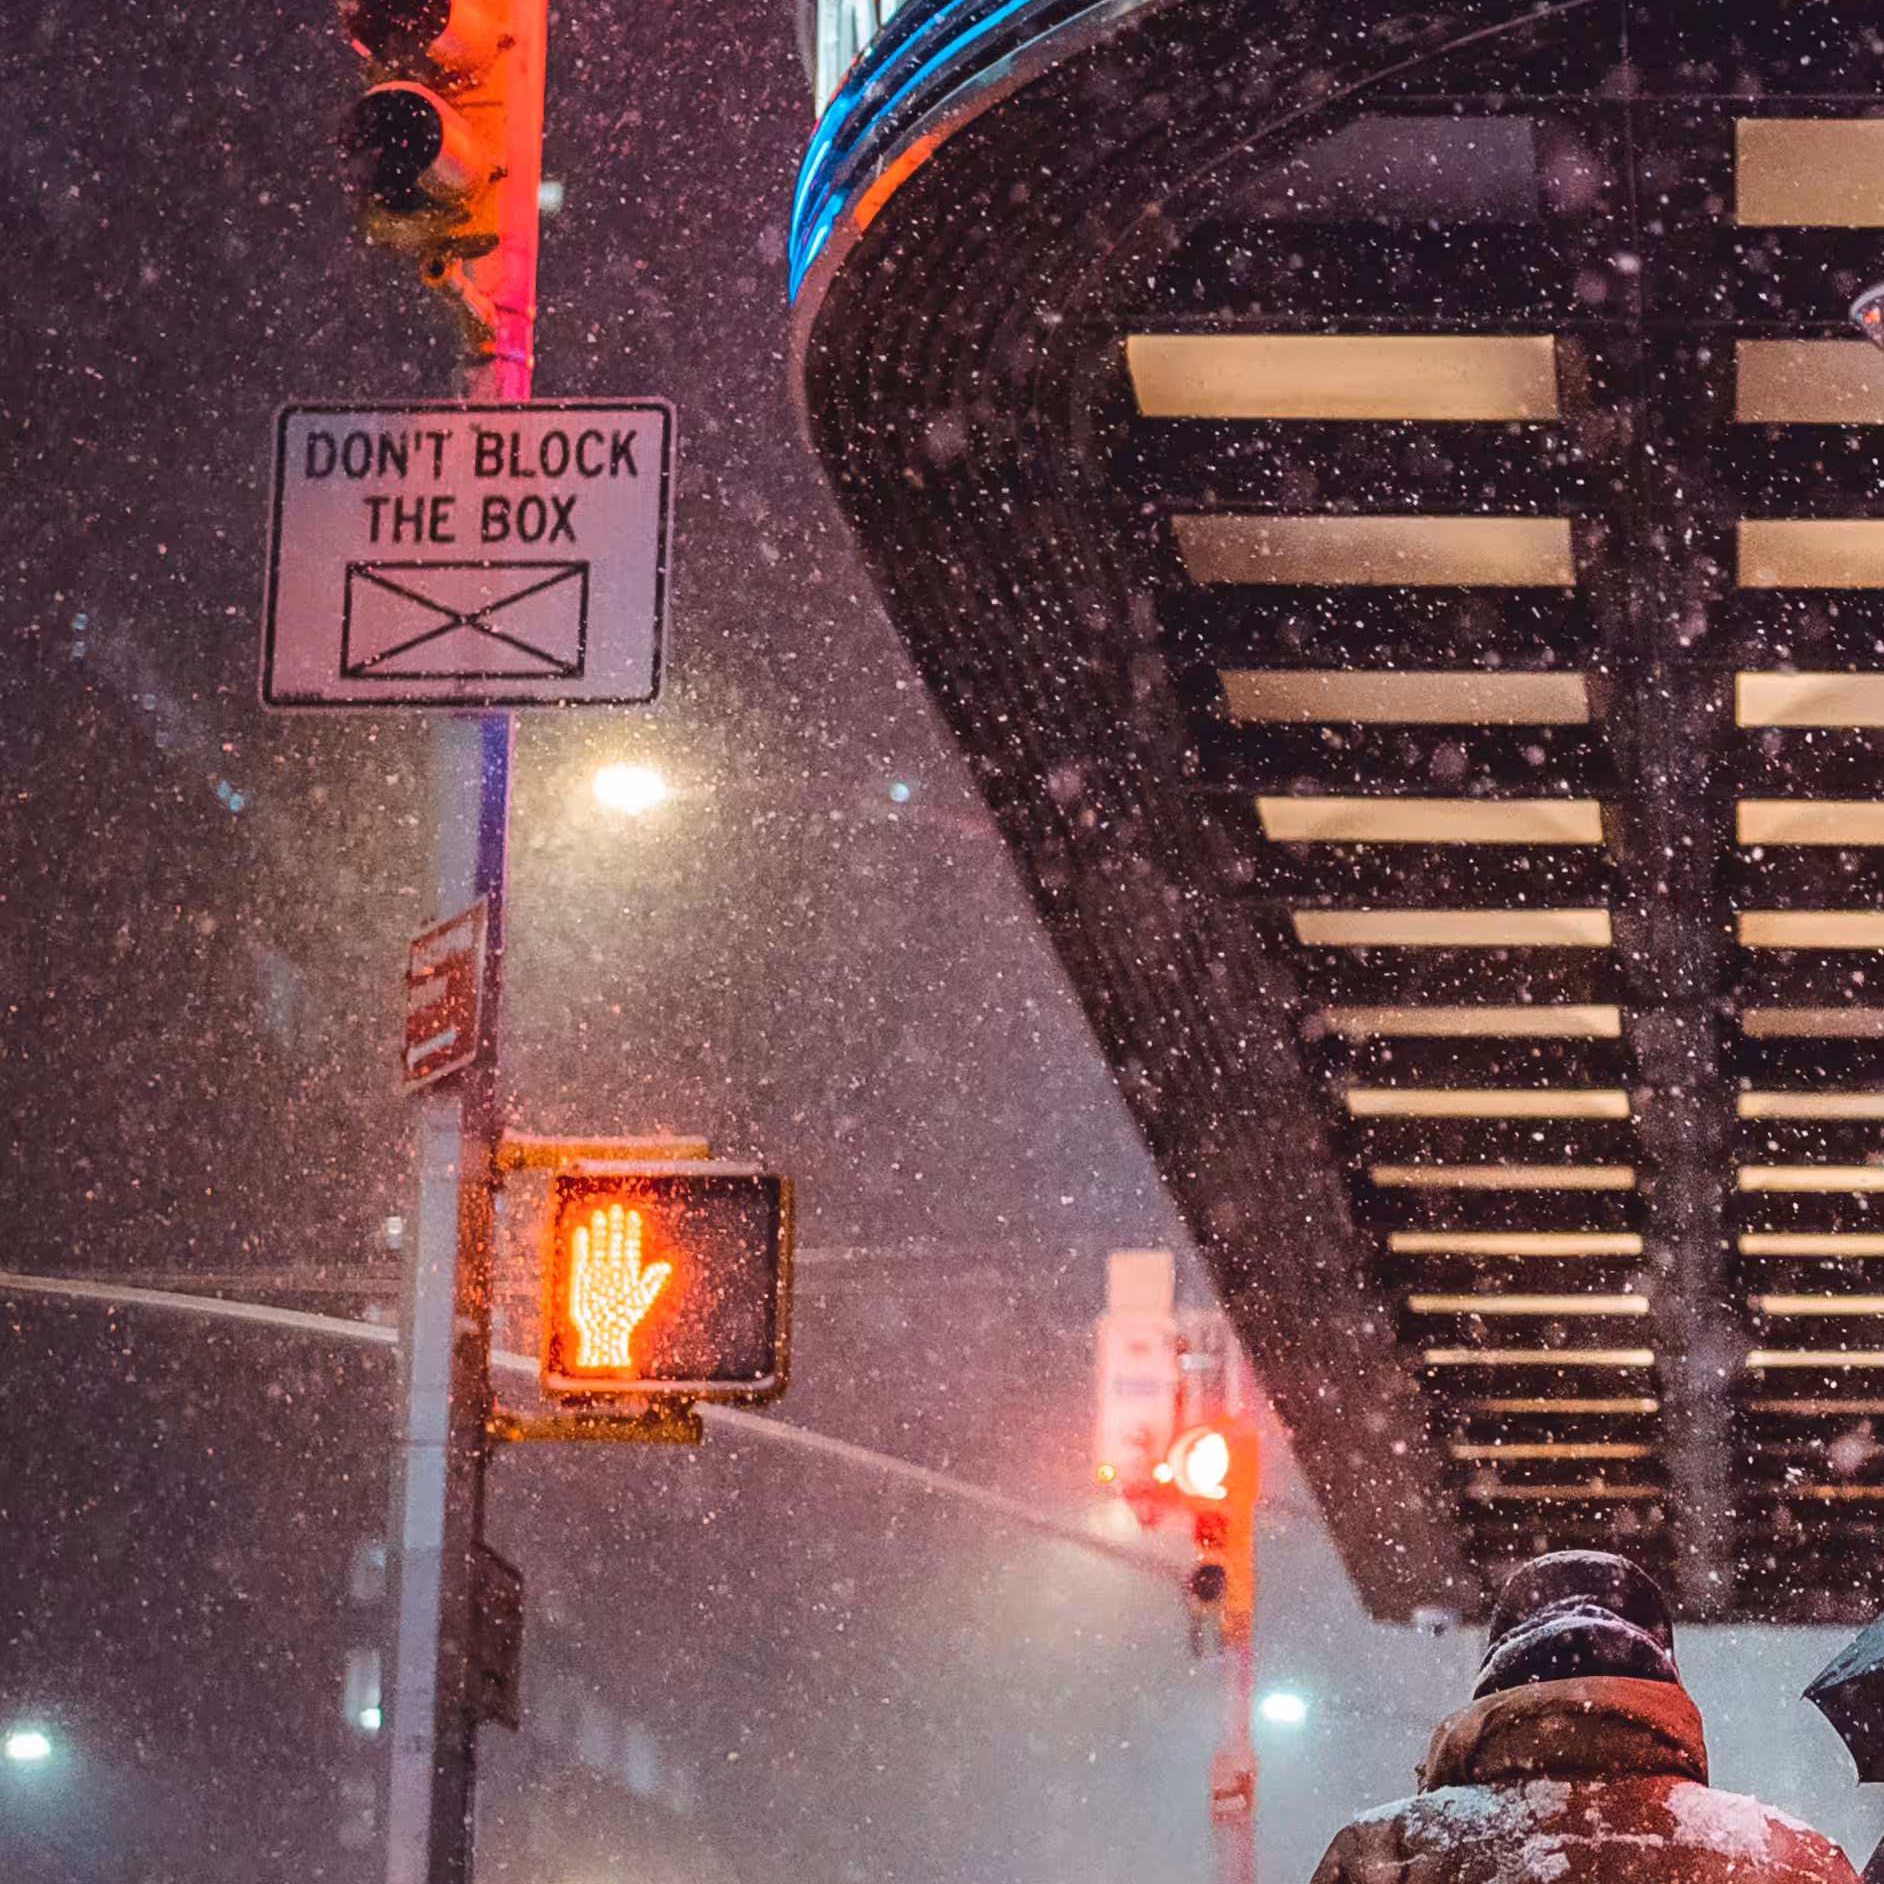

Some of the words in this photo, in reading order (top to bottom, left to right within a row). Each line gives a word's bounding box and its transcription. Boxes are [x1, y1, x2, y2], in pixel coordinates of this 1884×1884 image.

[304, 430, 453, 480] DON'T
[474, 428, 640, 480] BLOCK
[363, 495, 456, 544] THE
[481, 494, 577, 544] BOX
